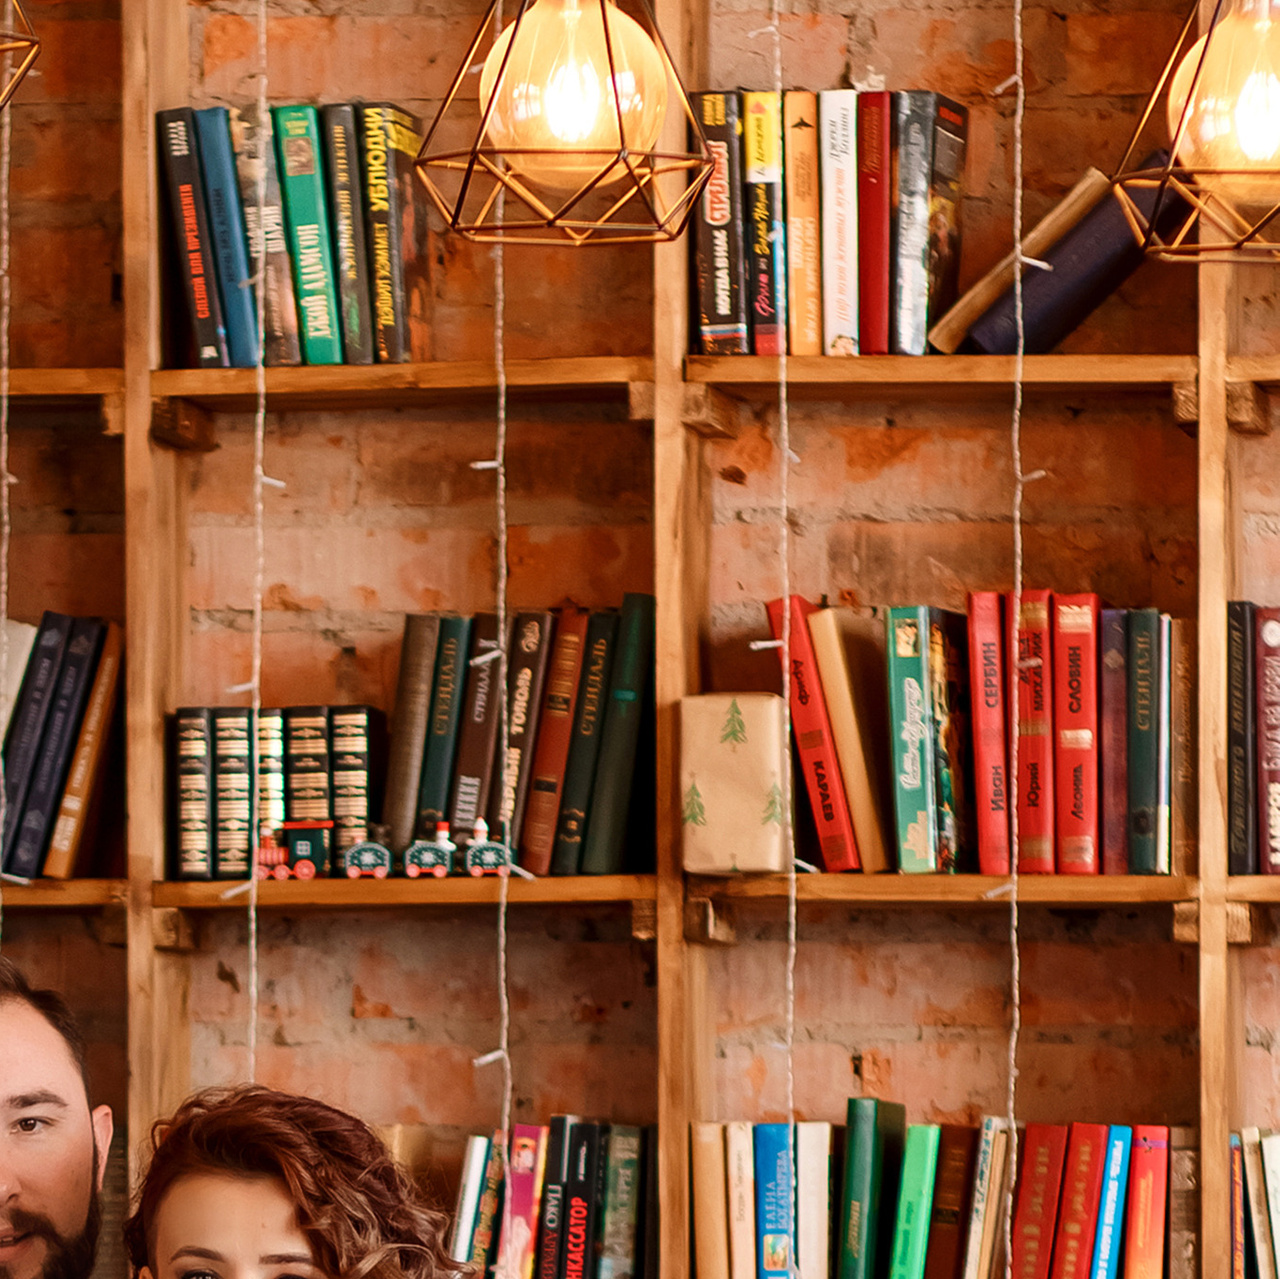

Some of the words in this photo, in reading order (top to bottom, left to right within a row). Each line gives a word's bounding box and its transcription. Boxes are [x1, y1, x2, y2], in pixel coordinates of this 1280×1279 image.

[177, 183, 201, 250] ПРЕЗИДЕНТА
[188, 251, 204, 275] ДЛЯ
[295, 223, 327, 290] АДАМСОН
[192, 276, 210, 319] СЛЕПОЙ
[431, 636, 460, 736] СТЕНДАЛЬ
[509, 666, 532, 735] ТОПОЛЬ
[579, 636, 608, 735] СТЕНДАЛЬ
[788, 657, 812, 706] Ариф
[981, 641, 998, 707] СЕРБИН
[1067, 646, 1082, 713] СЛОВИН
[1134, 632, 1151, 731] СТЕНДАЛЬ
[988, 765, 1004, 810] Иван
[1024, 762, 1041, 806] Юрий
[1070, 764, 1085, 819] Леонид
[563, 1195, 589, 1279] НКАССАТОР
[763, 1180, 777, 1229] ЕЛЕНА
